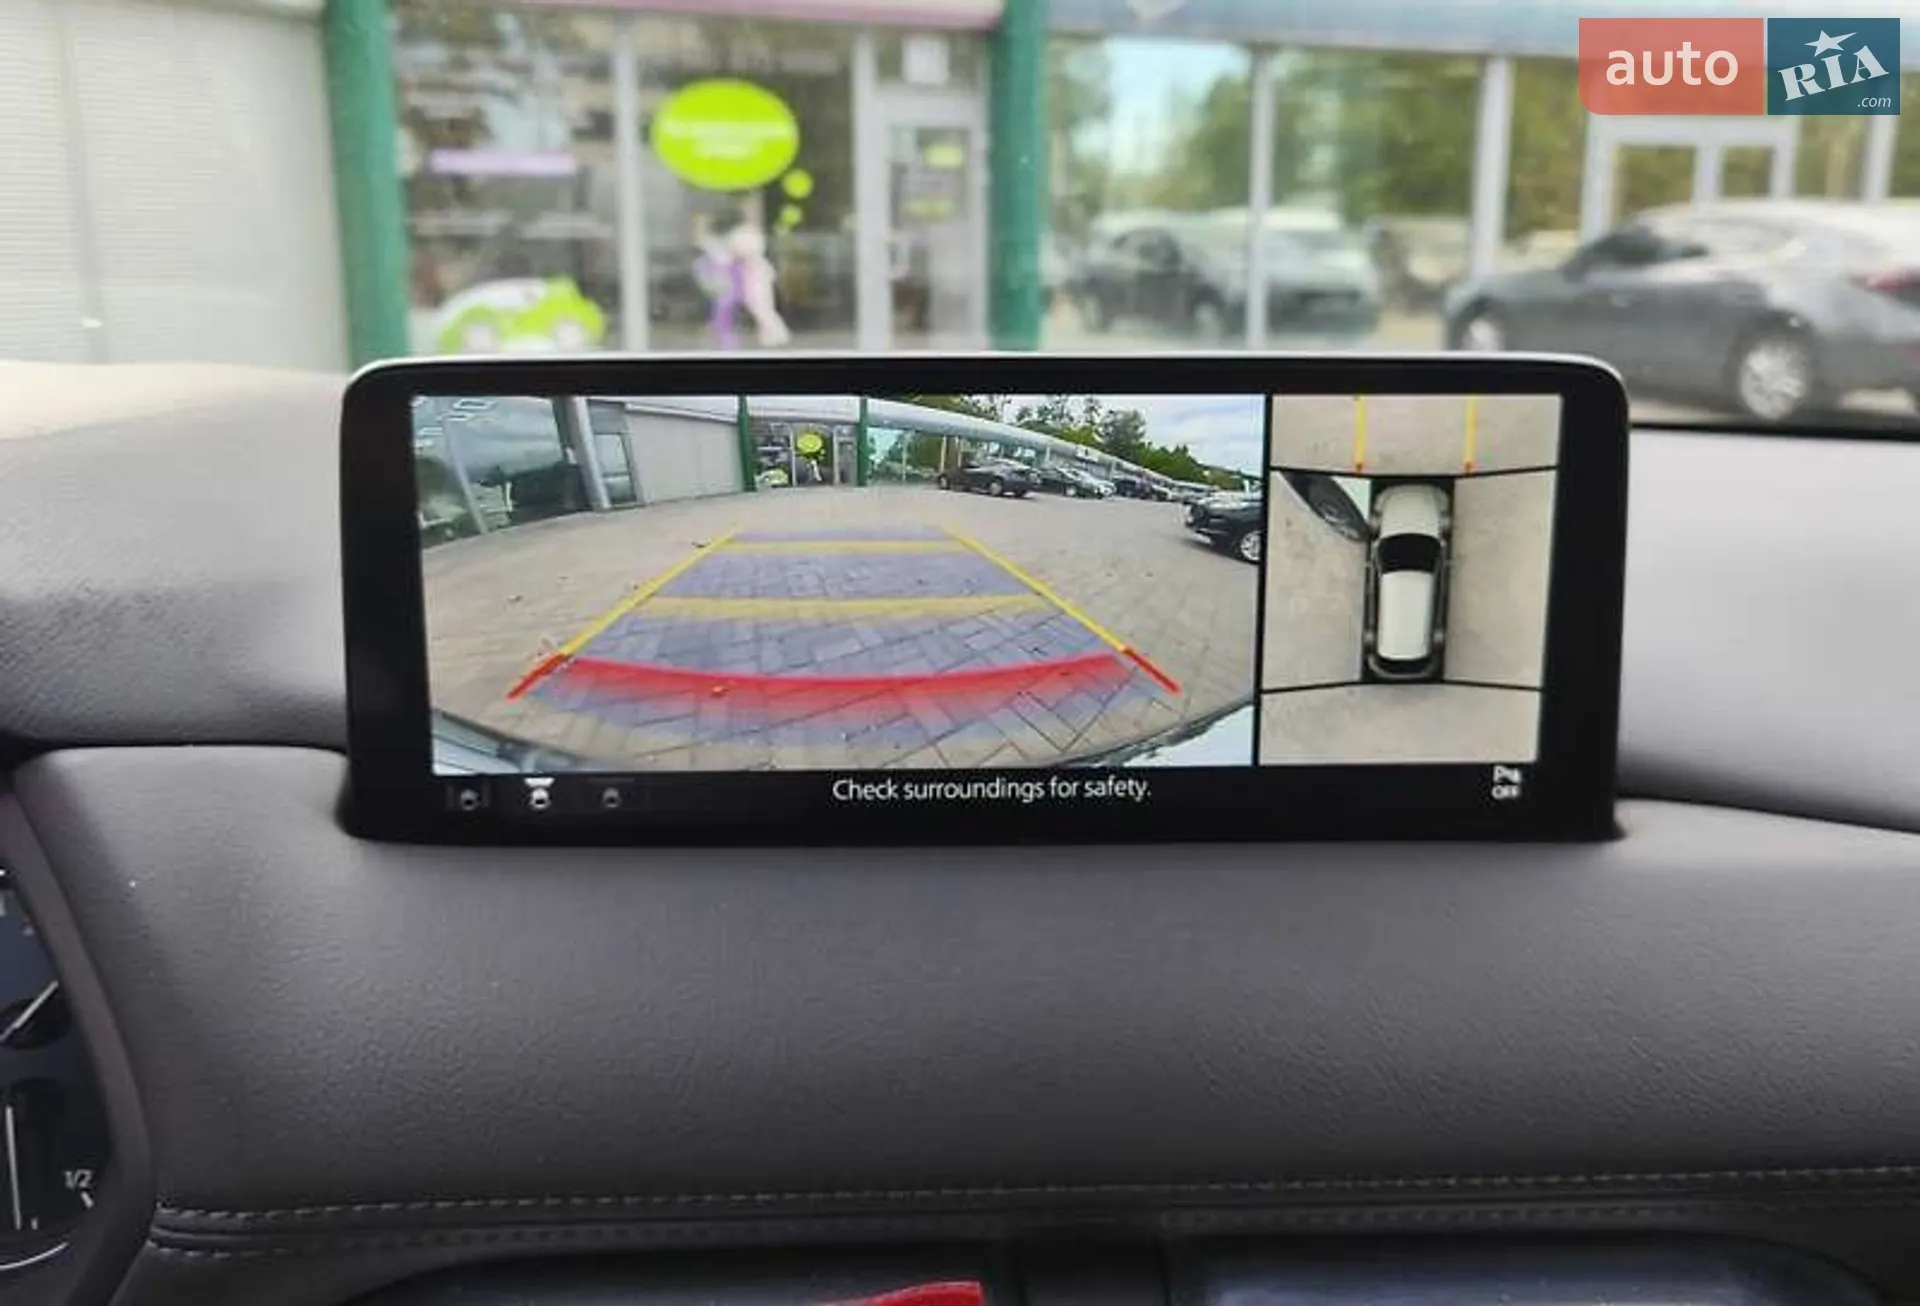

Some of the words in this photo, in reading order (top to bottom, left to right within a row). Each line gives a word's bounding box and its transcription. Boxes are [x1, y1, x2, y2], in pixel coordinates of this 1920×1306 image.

[832, 778, 899, 800] Check
[903, 777, 1045, 803] surroundings
[1051, 776, 1080, 798] for
[1084, 775, 1152, 801] safety.
